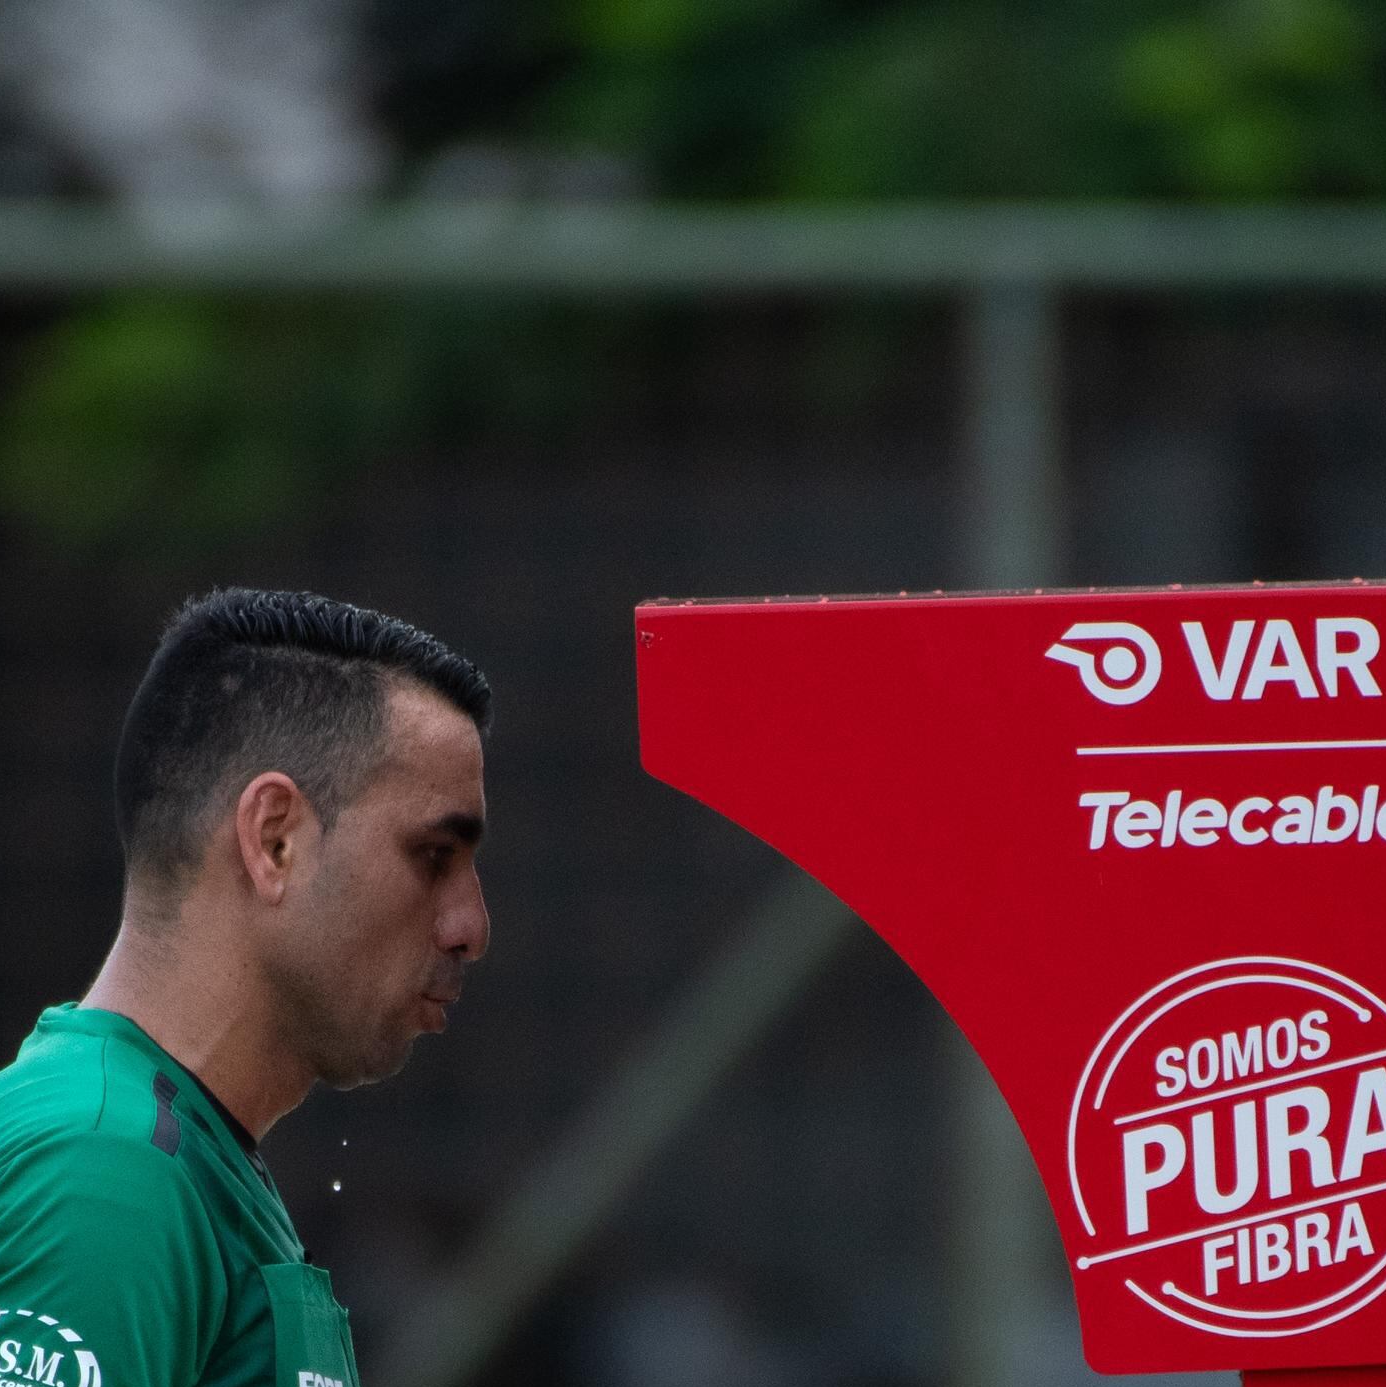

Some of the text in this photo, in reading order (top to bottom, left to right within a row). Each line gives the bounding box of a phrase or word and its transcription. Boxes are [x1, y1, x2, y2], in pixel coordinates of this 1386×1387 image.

[1181, 617, 1383, 701] VAR
[1156, 1010, 1331, 1098] SOMOS
[1203, 1203, 1375, 1297] FIBRA
